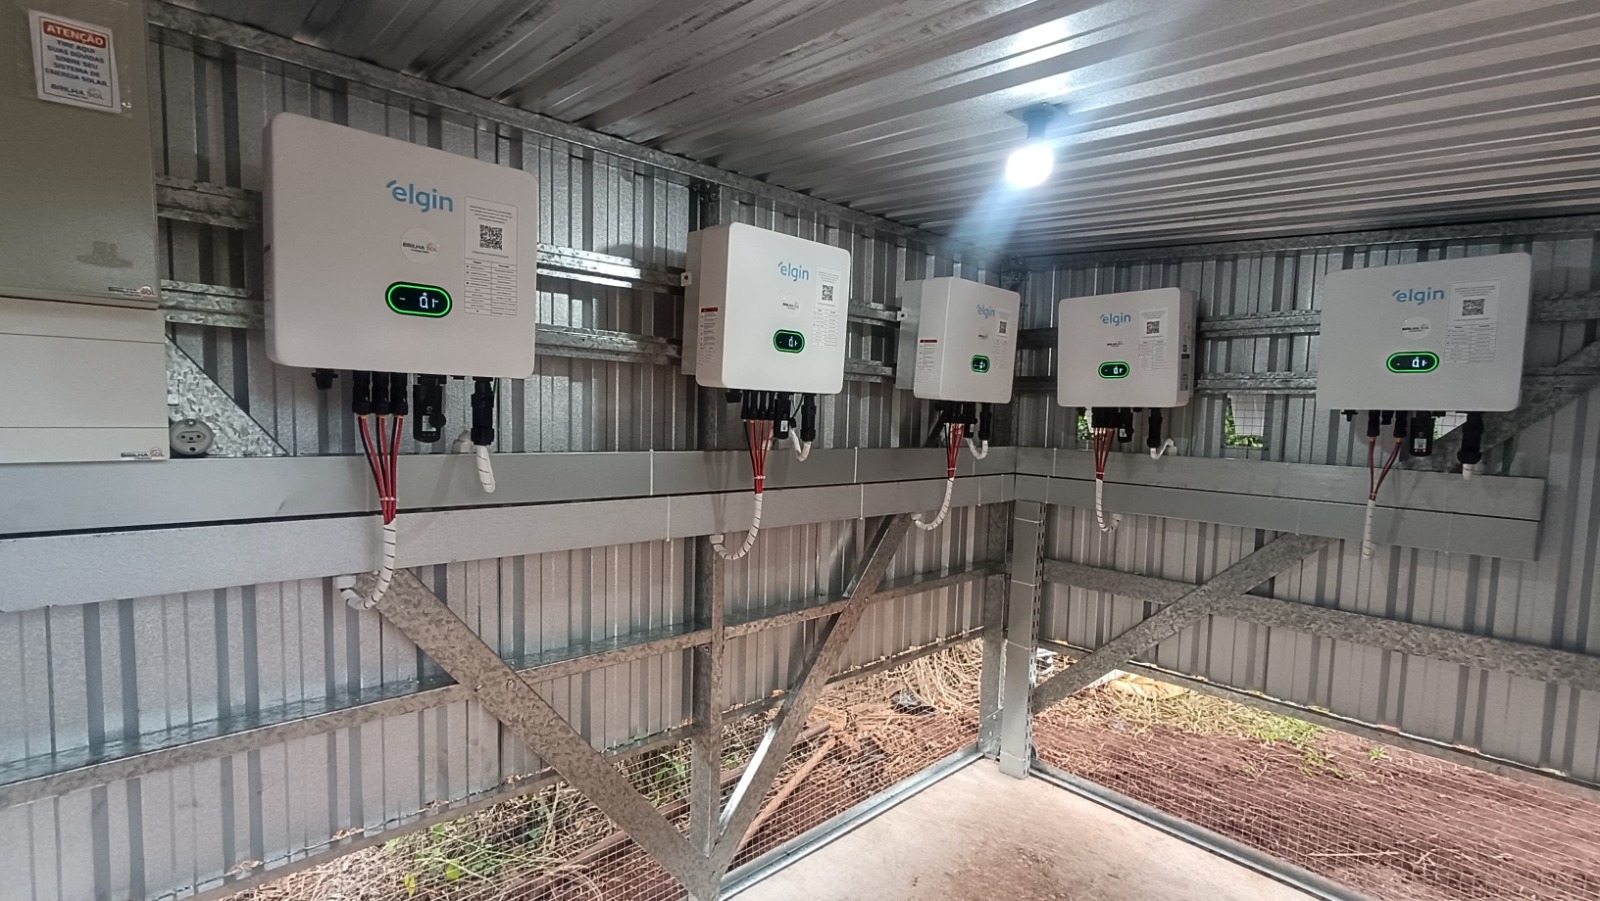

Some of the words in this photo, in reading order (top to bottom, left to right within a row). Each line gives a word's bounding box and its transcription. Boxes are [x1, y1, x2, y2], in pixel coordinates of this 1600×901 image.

[46, 23, 104, 46] ATENÇÃO
[47, 45, 69, 55] SUAS
[57, 40, 74, 49] TIRE
[76, 45, 96, 54] AQUI
[53, 62, 88, 75] SISTEMA
[55, 55, 80, 65] SOBRE
[82, 61, 98, 70] SEU
[45, 68, 80, 80] ENERGIA
[51, 83, 85, 96] BRILHA
[386, 180, 453, 213] elgin
[402, 242, 425, 250] BRILHA
[778, 261, 809, 282] elgin
[1392, 287, 1445, 305] elgin
[1100, 312, 1131, 326] elgin
